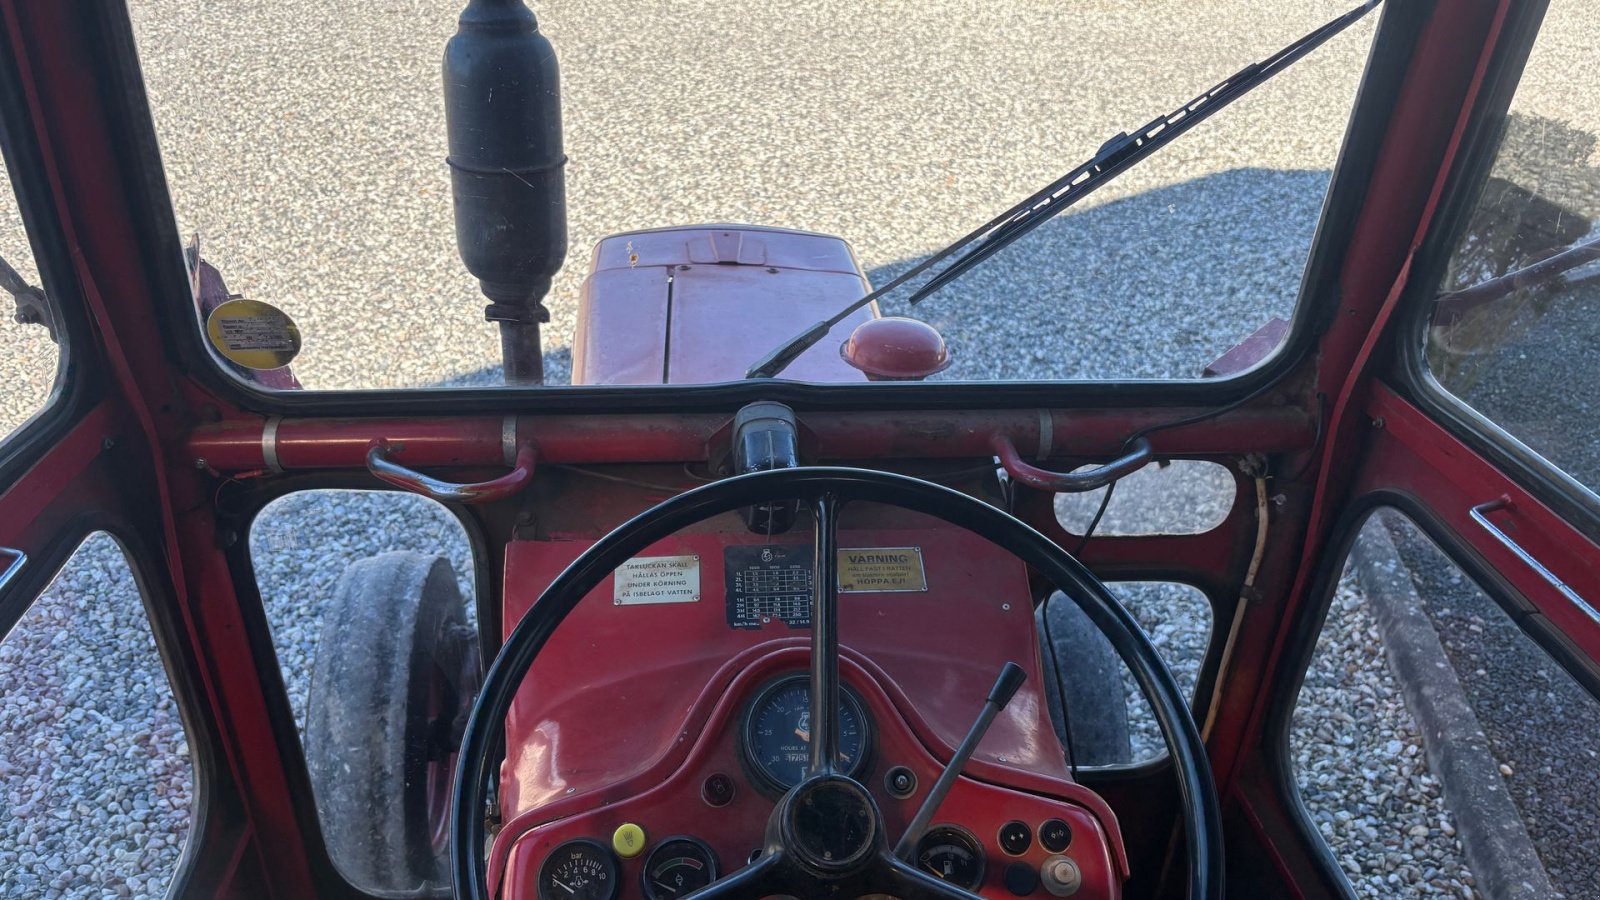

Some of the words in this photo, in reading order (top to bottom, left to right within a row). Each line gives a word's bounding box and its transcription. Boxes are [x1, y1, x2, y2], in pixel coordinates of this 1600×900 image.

[848, 555, 908, 563] VARNING
[626, 562, 667, 570] TAKLUCKAN
[632, 570, 658, 578] HÅLLAS
[660, 570, 683, 578] ÖPPEN
[653, 579, 687, 587] KÖRNING
[573, 866, 579, 874] 4
[583, 866, 588, 874] 6
[591, 868, 596, 876] 8
[563, 871, 569, 879] 2
[599, 872, 606, 880] 10
